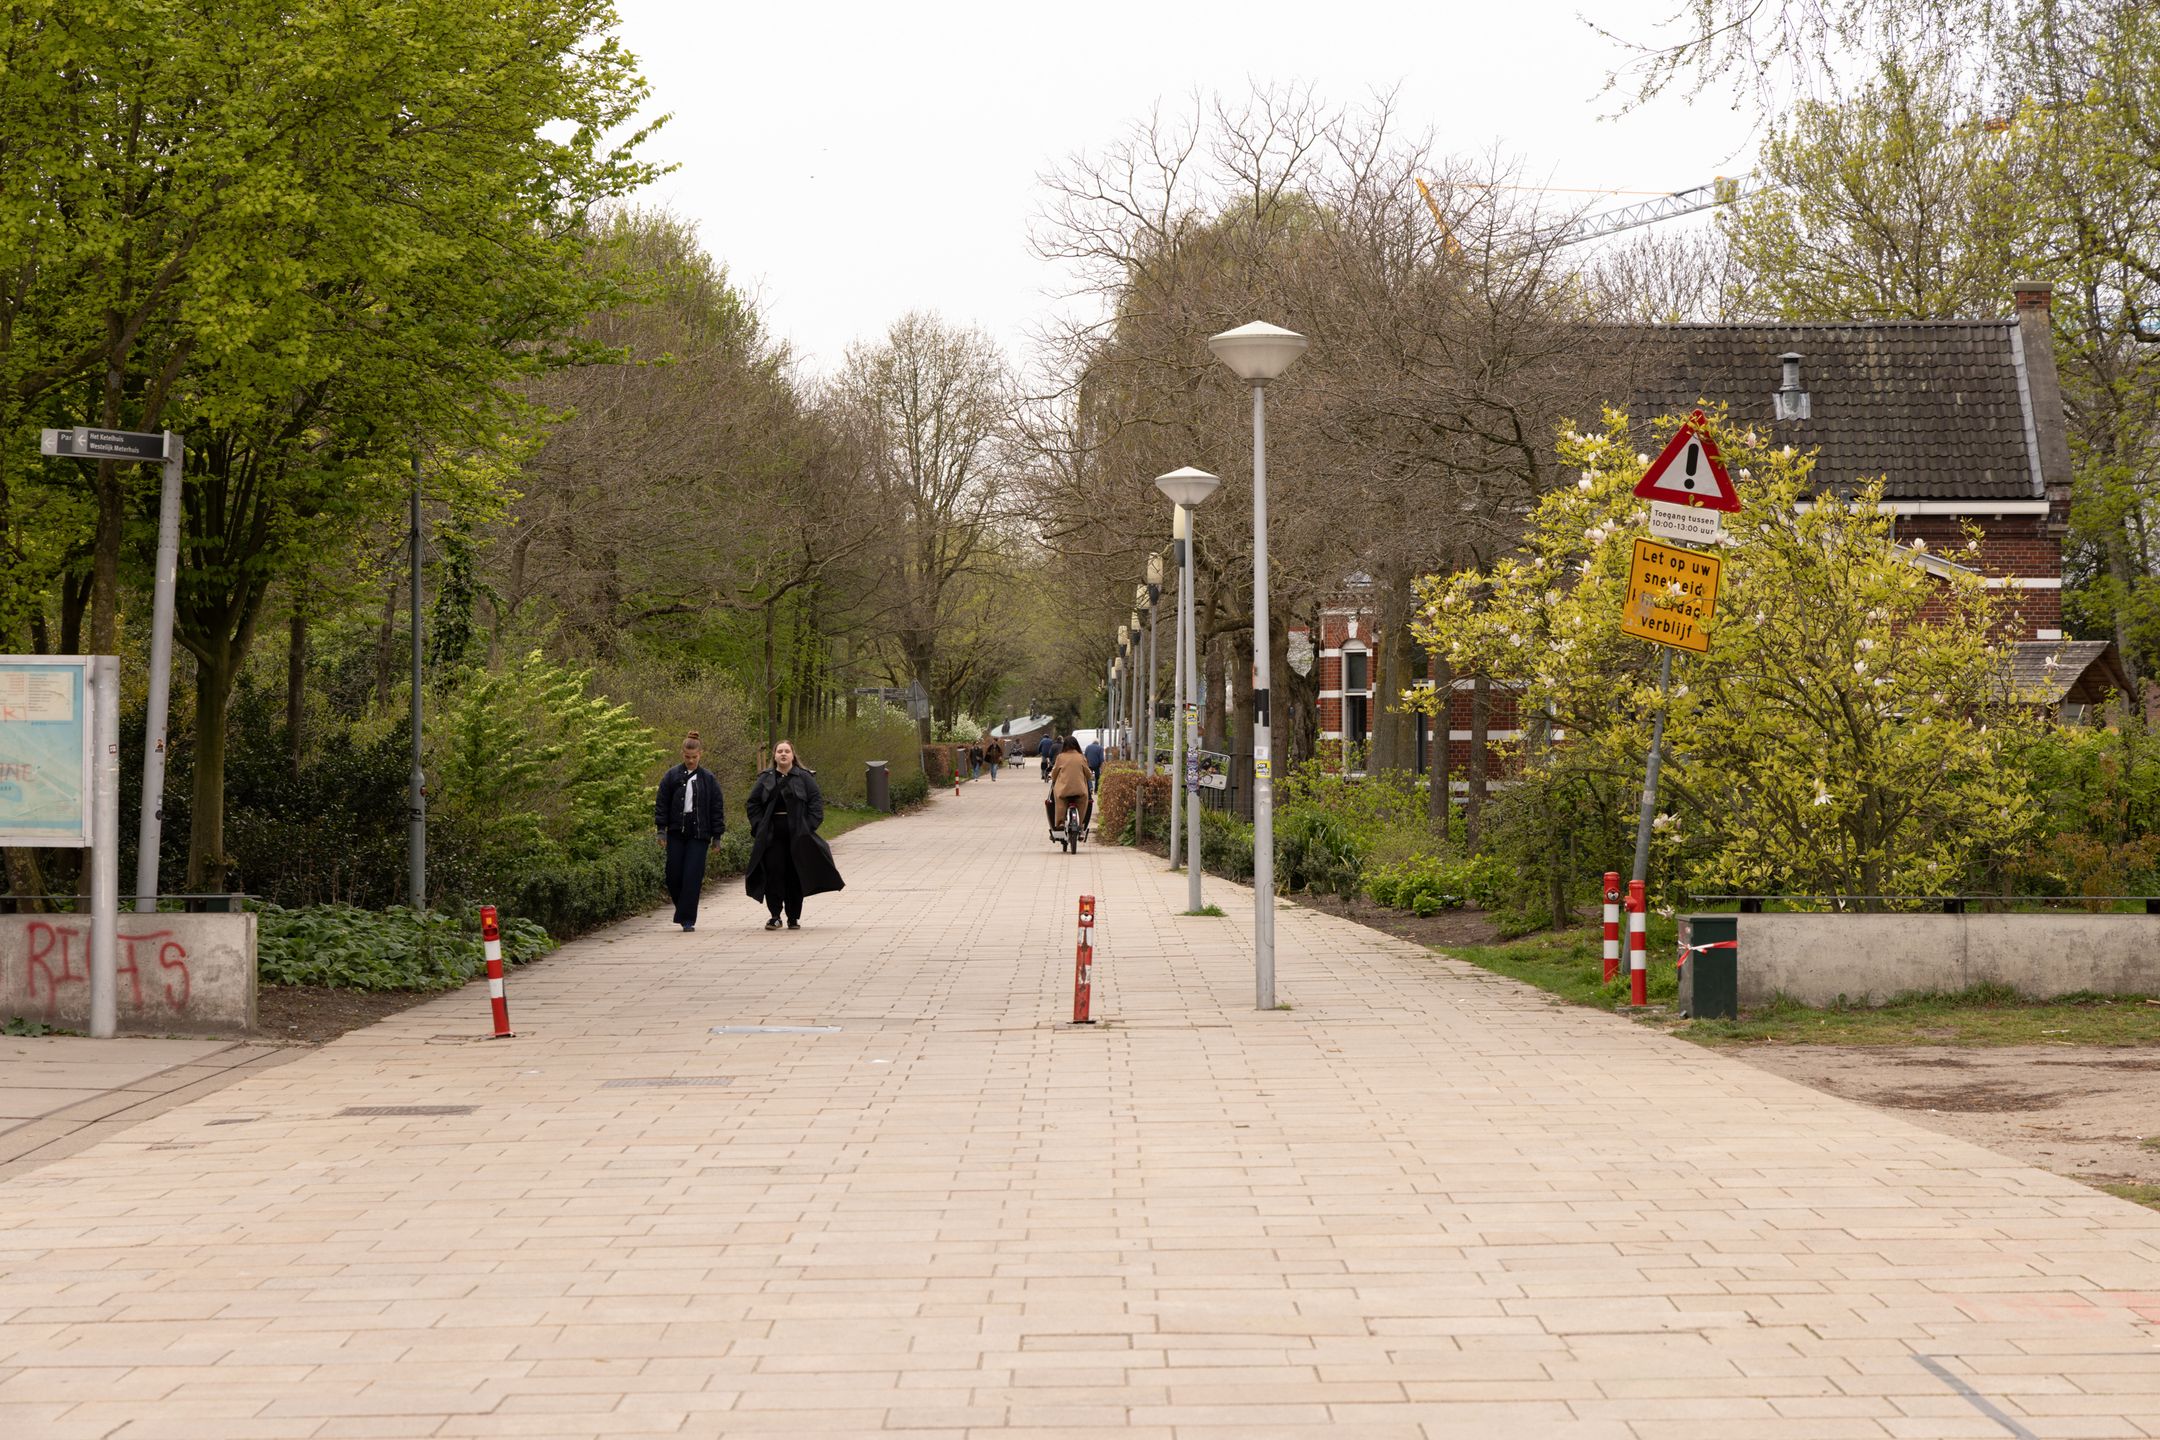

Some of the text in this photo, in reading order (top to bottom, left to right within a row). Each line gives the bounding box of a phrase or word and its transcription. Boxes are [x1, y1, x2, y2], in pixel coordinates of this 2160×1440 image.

[100, 434, 124, 442] Ketelhuis
[90, 443, 113, 451] Westelijk
[1655, 510, 1715, 526] Toegang tussen
[1652, 520, 1714, 535] 10:00-13:00 uur
[1642, 547, 1710, 576] Let op uw
[1641, 616, 1693, 641] verblijf
